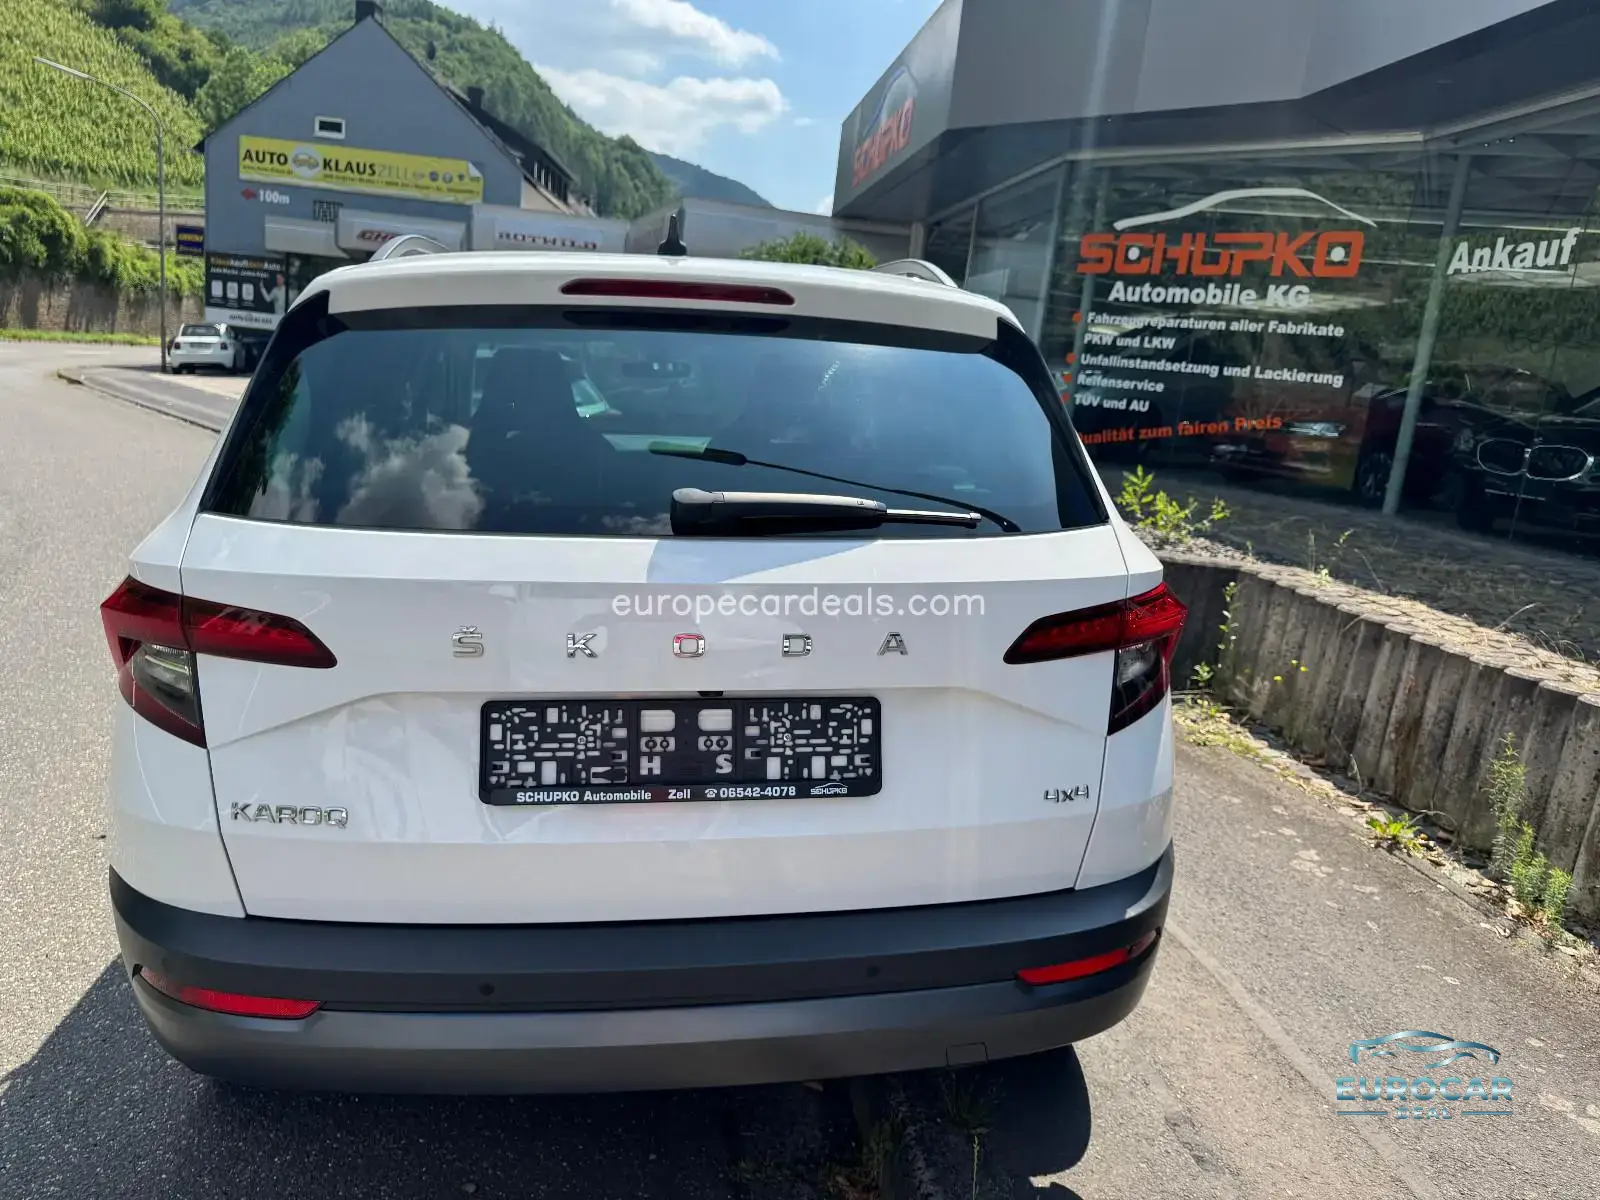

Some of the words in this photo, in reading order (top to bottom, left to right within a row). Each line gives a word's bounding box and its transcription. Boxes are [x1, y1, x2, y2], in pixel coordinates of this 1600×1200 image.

[243, 149, 288, 165] AUTO
[323, 158, 376, 176] KLAUS
[258, 189, 290, 205] 100m
[1077, 231, 1364, 277] SCHUPKO
[1446, 227, 1580, 275] Ankauf
[1108, 280, 1256, 305] Automobile
[1266, 284, 1310, 307] KG
[1087, 312, 1226, 331] Fahrzeugreparaturen
[1230, 320, 1263, 333] aller
[1268, 320, 1344, 338] Fabrikate
[1084, 334, 1114, 346] PKW
[1116, 336, 1140, 348] und
[1143, 337, 1176, 349] LKW
[1077, 374, 1164, 392] Reifenservice
[1081, 354, 1219, 378] Unfallinstandsetzung
[1223, 366, 1250, 378] und
[1254, 365, 1344, 388] Lackierung
[1074, 392, 1101, 407] TÜV
[1103, 397, 1126, 410] und
[1129, 400, 1150, 412] AU
[1138, 426, 1172, 440] zum
[1177, 419, 1229, 436] fairen
[1235, 415, 1282, 432] Preis
[516, 790, 579, 803] SCHUPKO
[584, 789, 652, 802] Automobile
[668, 789, 691, 799] Zell
[719, 786, 796, 798] 06542-4078
[1044, 784, 1089, 803] 4x4
[231, 802, 348, 829] KAROQ
